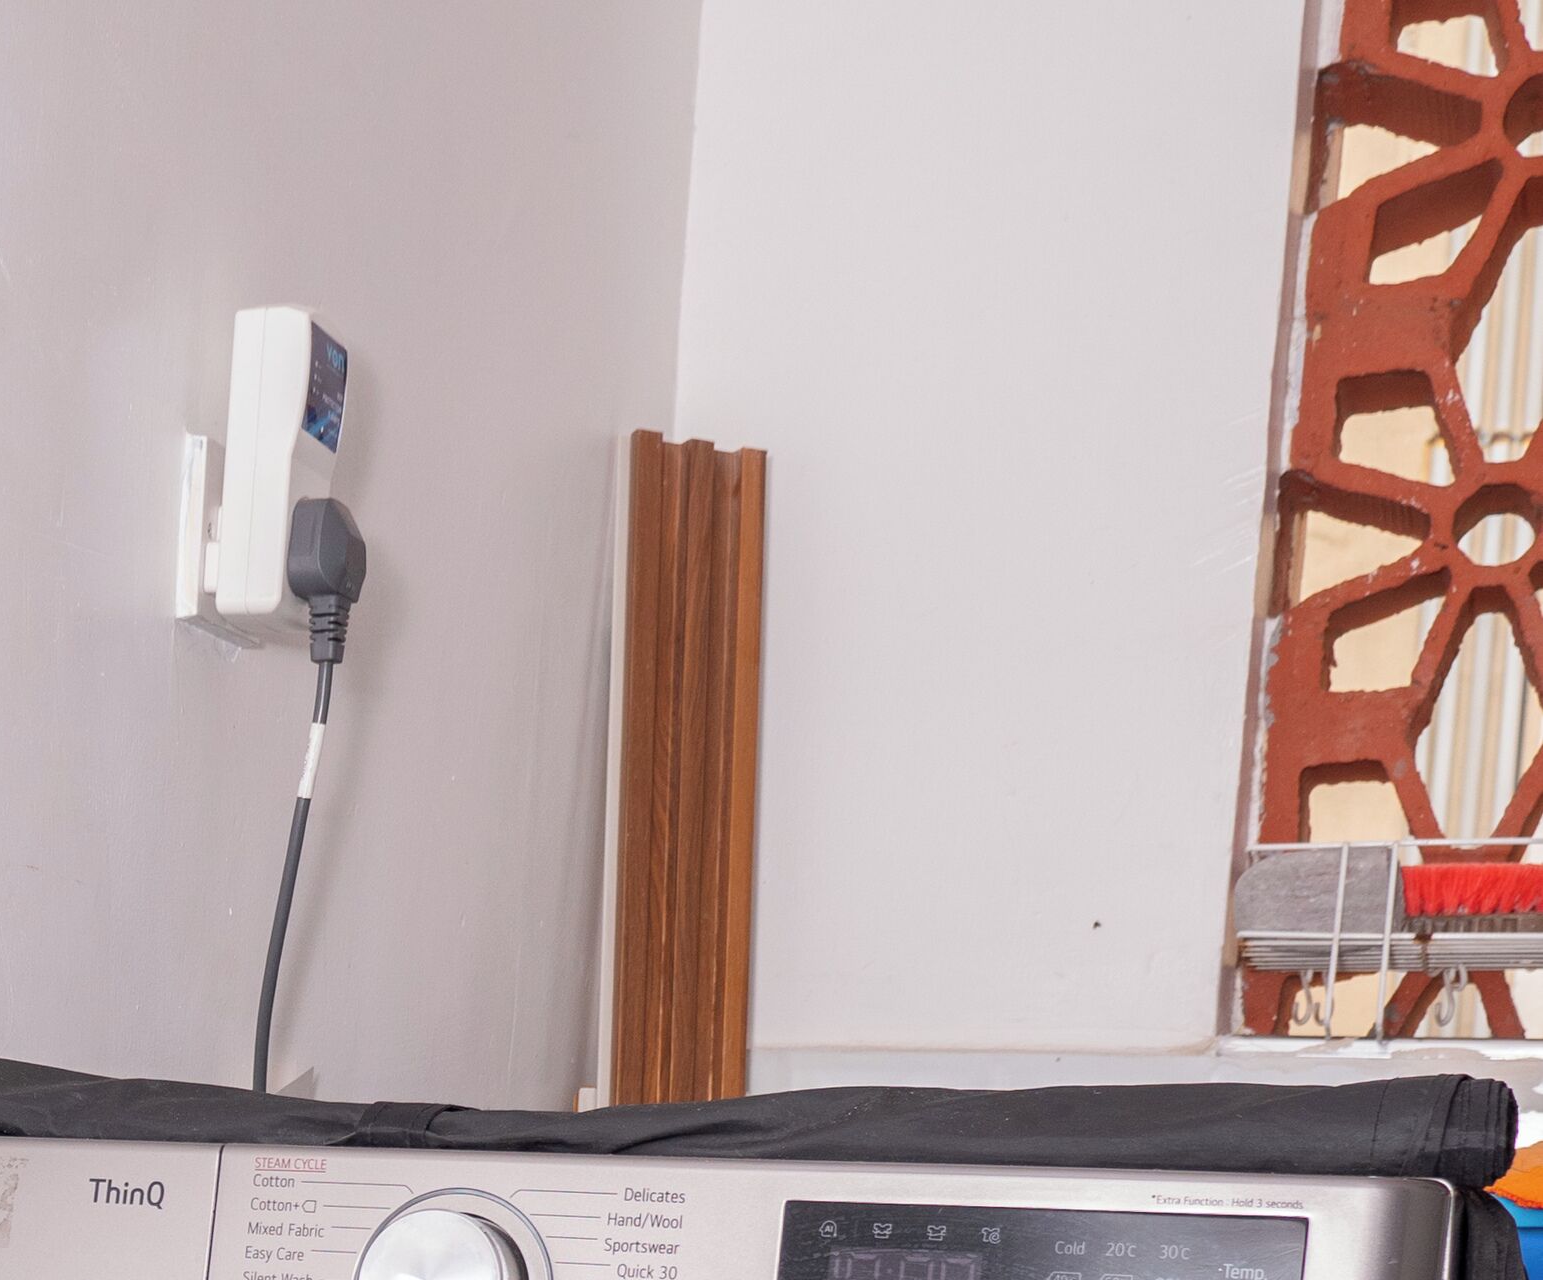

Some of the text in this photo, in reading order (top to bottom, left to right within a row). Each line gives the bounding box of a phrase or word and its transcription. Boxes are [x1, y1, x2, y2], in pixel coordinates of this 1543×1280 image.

[255, 1157, 327, 1170] STEAM CYCLE
[253, 1174, 295, 1188] Cotton
[89, 1177, 165, 1210] ThinQ
[624, 1187, 686, 1204] Delicates
[250, 1197, 300, 1212] Cotton+
[1184, 1196, 1223, 1207] Function
[1231, 1198, 1253, 1208] Hold
[1257, 1199, 1263, 1208] 3
[1266, 1199, 1304, 1210] seconds
[607, 1212, 683, 1229] Hand/Wool
[247, 1222, 325, 1238] Mixed Fabric
[245, 1246, 305, 1263] Easy Care
[604, 1238, 680, 1255] Sportswear
[1054, 1240, 1086, 1256] Cold
[617, 1264, 678, 1280] Quick 30
